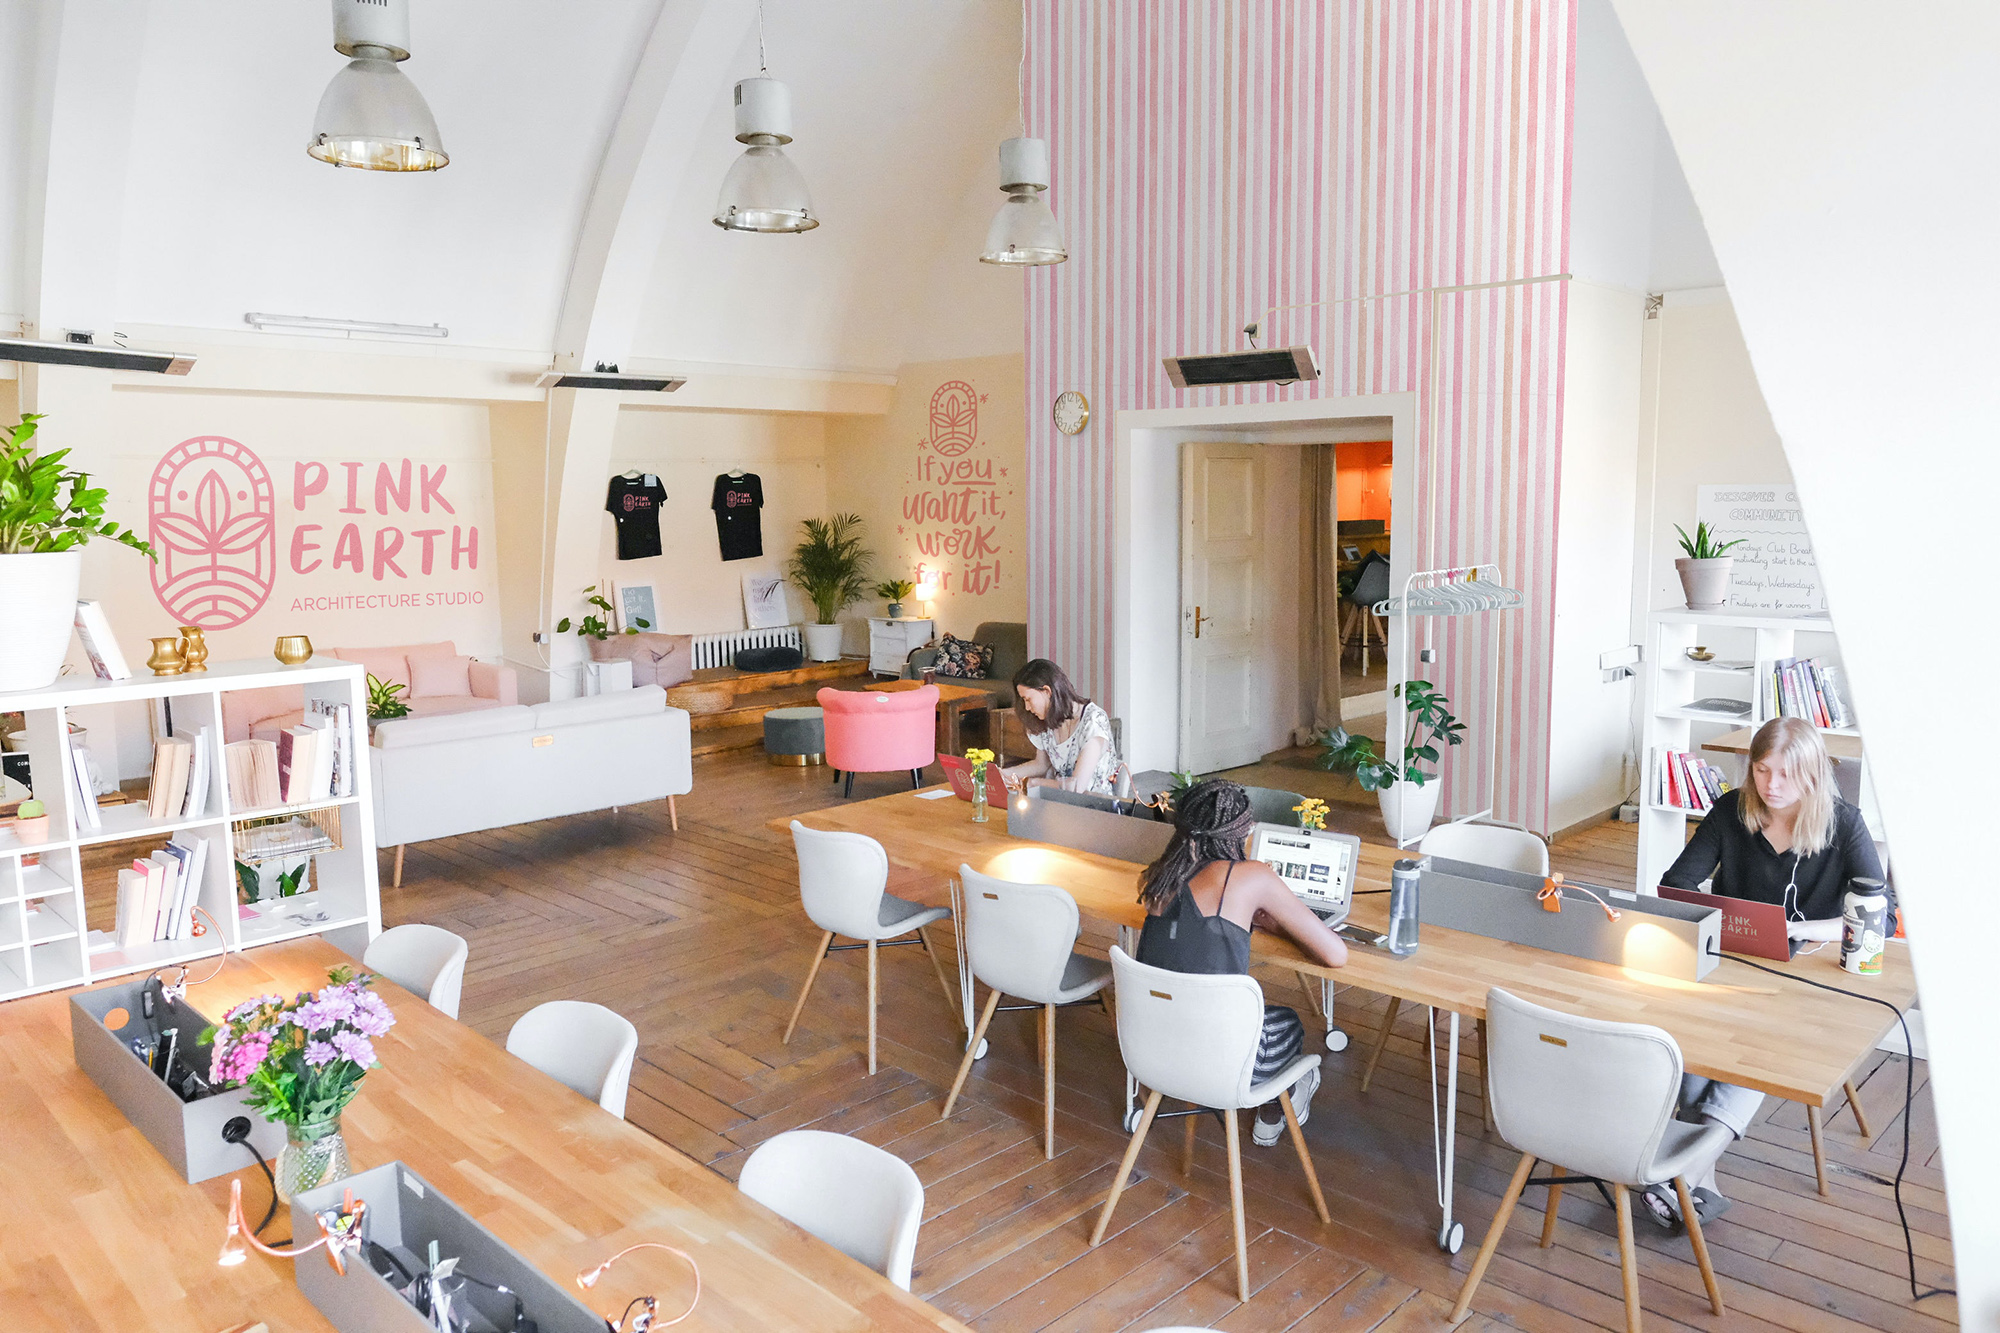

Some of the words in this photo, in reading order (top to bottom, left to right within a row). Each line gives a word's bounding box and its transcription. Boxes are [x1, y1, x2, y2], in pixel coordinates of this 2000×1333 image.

[917, 455, 936, 482] If
[937, 458, 992, 486] you
[293, 457, 456, 516] PINK
[903, 487, 979, 525] want
[982, 490, 1006, 520] it,
[290, 522, 479, 581] EARTH
[916, 525, 1001, 560] work
[1766, 542, 1786, 554] Club
[1772, 556, 1787, 565] start
[915, 562, 952, 590] for
[962, 559, 1000, 596] it!
[1767, 575, 1815, 596] Wednesdays
[290, 592, 421, 612] ARCHITECTURE
[425, 590, 484, 607] STUDIO
[1730, 593, 1758, 609] Fridays
[1721, 923, 1757, 936] EARTH
